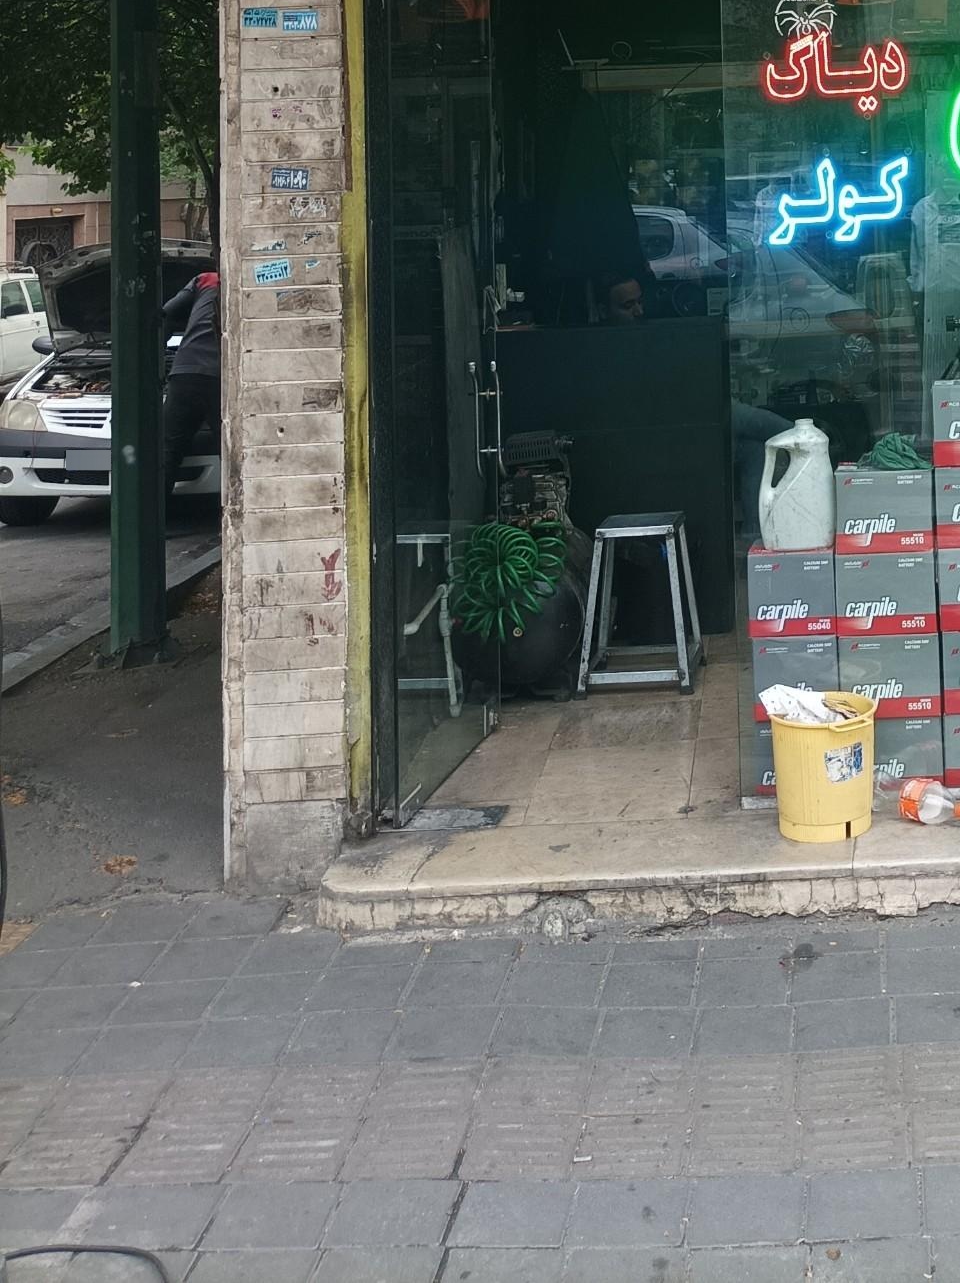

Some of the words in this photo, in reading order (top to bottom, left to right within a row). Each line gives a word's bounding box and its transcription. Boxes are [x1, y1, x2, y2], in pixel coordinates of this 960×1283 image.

[768, 155, 910, 246] کولر
[845, 513, 896, 546] carpile
[900, 536, 925, 545] 55510
[757, 599, 809, 632] carpile
[807, 622, 831, 631] 55040
[845, 597, 898, 630] carpile
[901, 619, 926, 628] 55510
[852, 679, 904, 713] carpile
[908, 702, 932, 711] 55510
